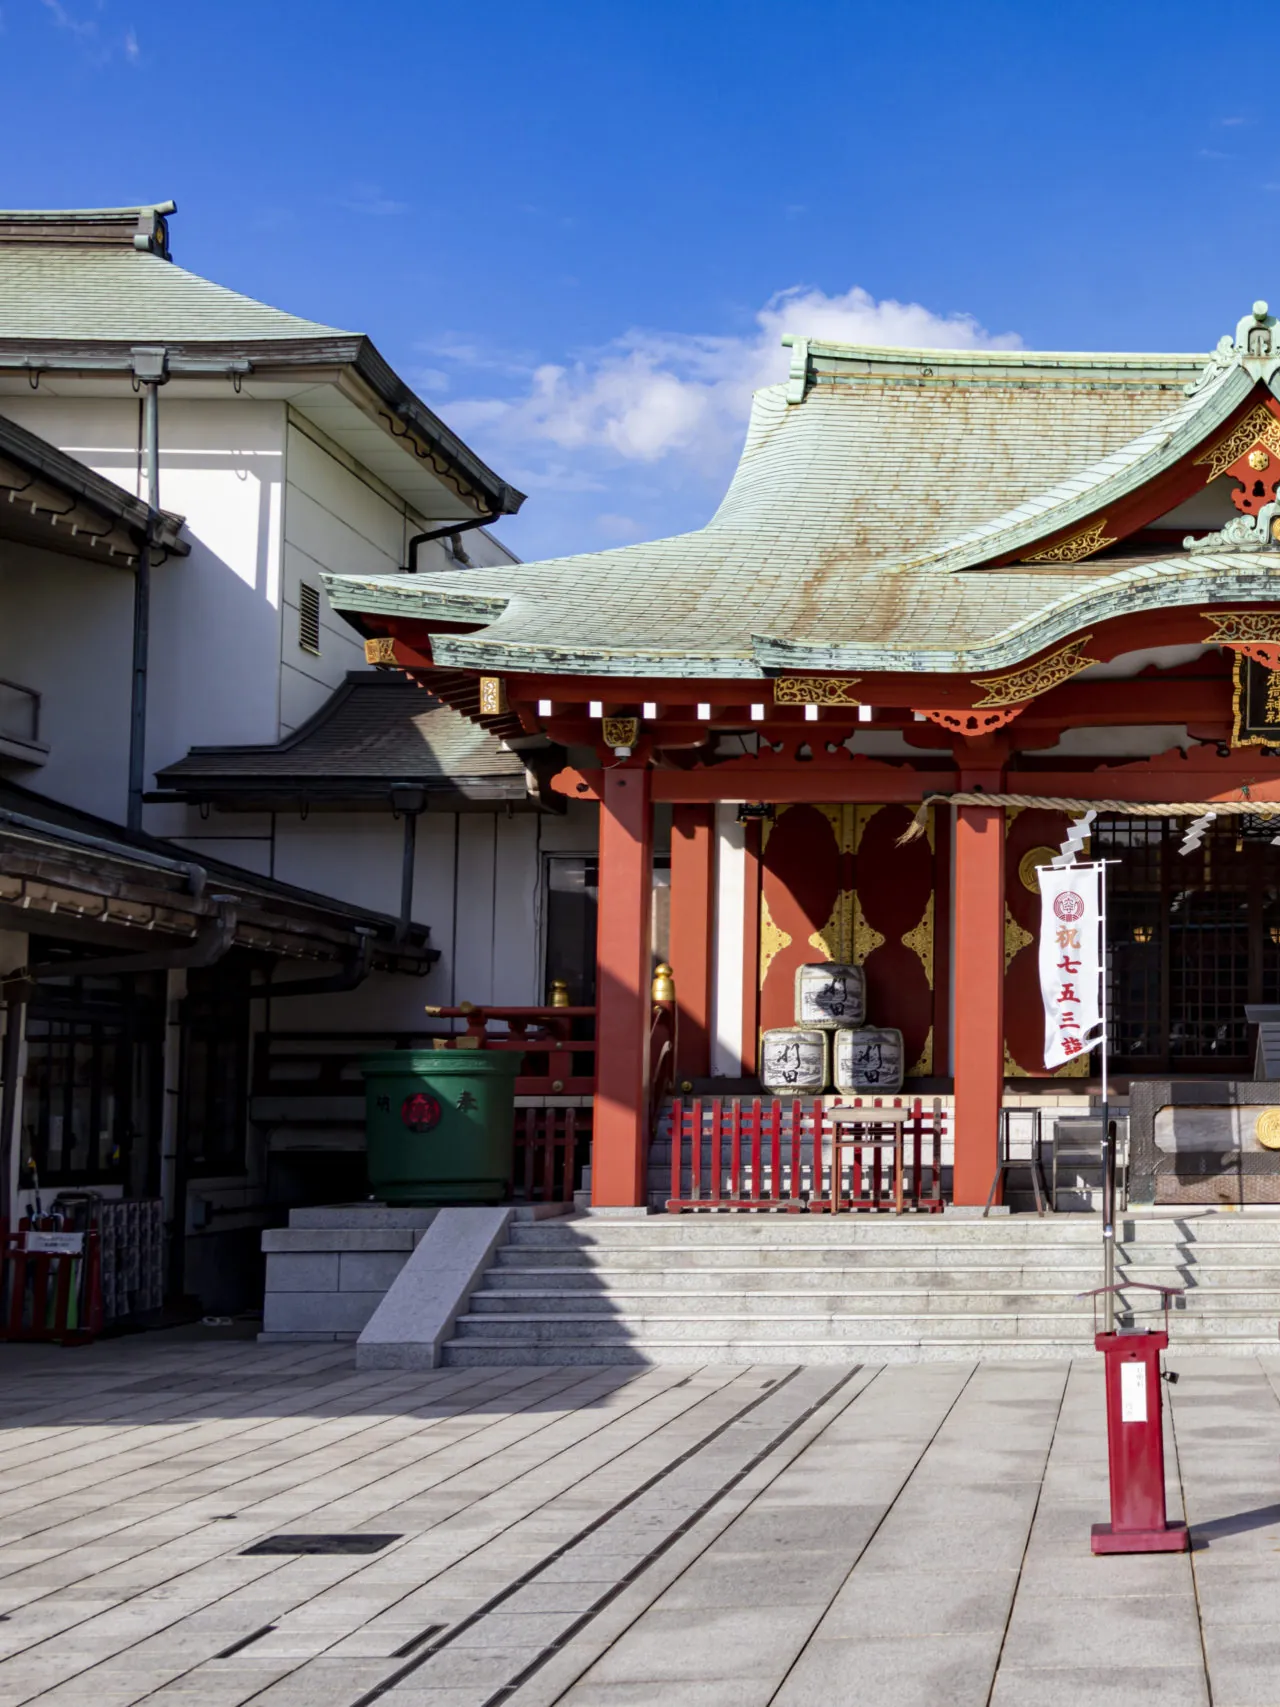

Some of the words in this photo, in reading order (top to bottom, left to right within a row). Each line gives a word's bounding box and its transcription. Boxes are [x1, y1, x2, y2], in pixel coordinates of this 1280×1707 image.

[1055, 925, 1083, 1055] 祝七五三詣
